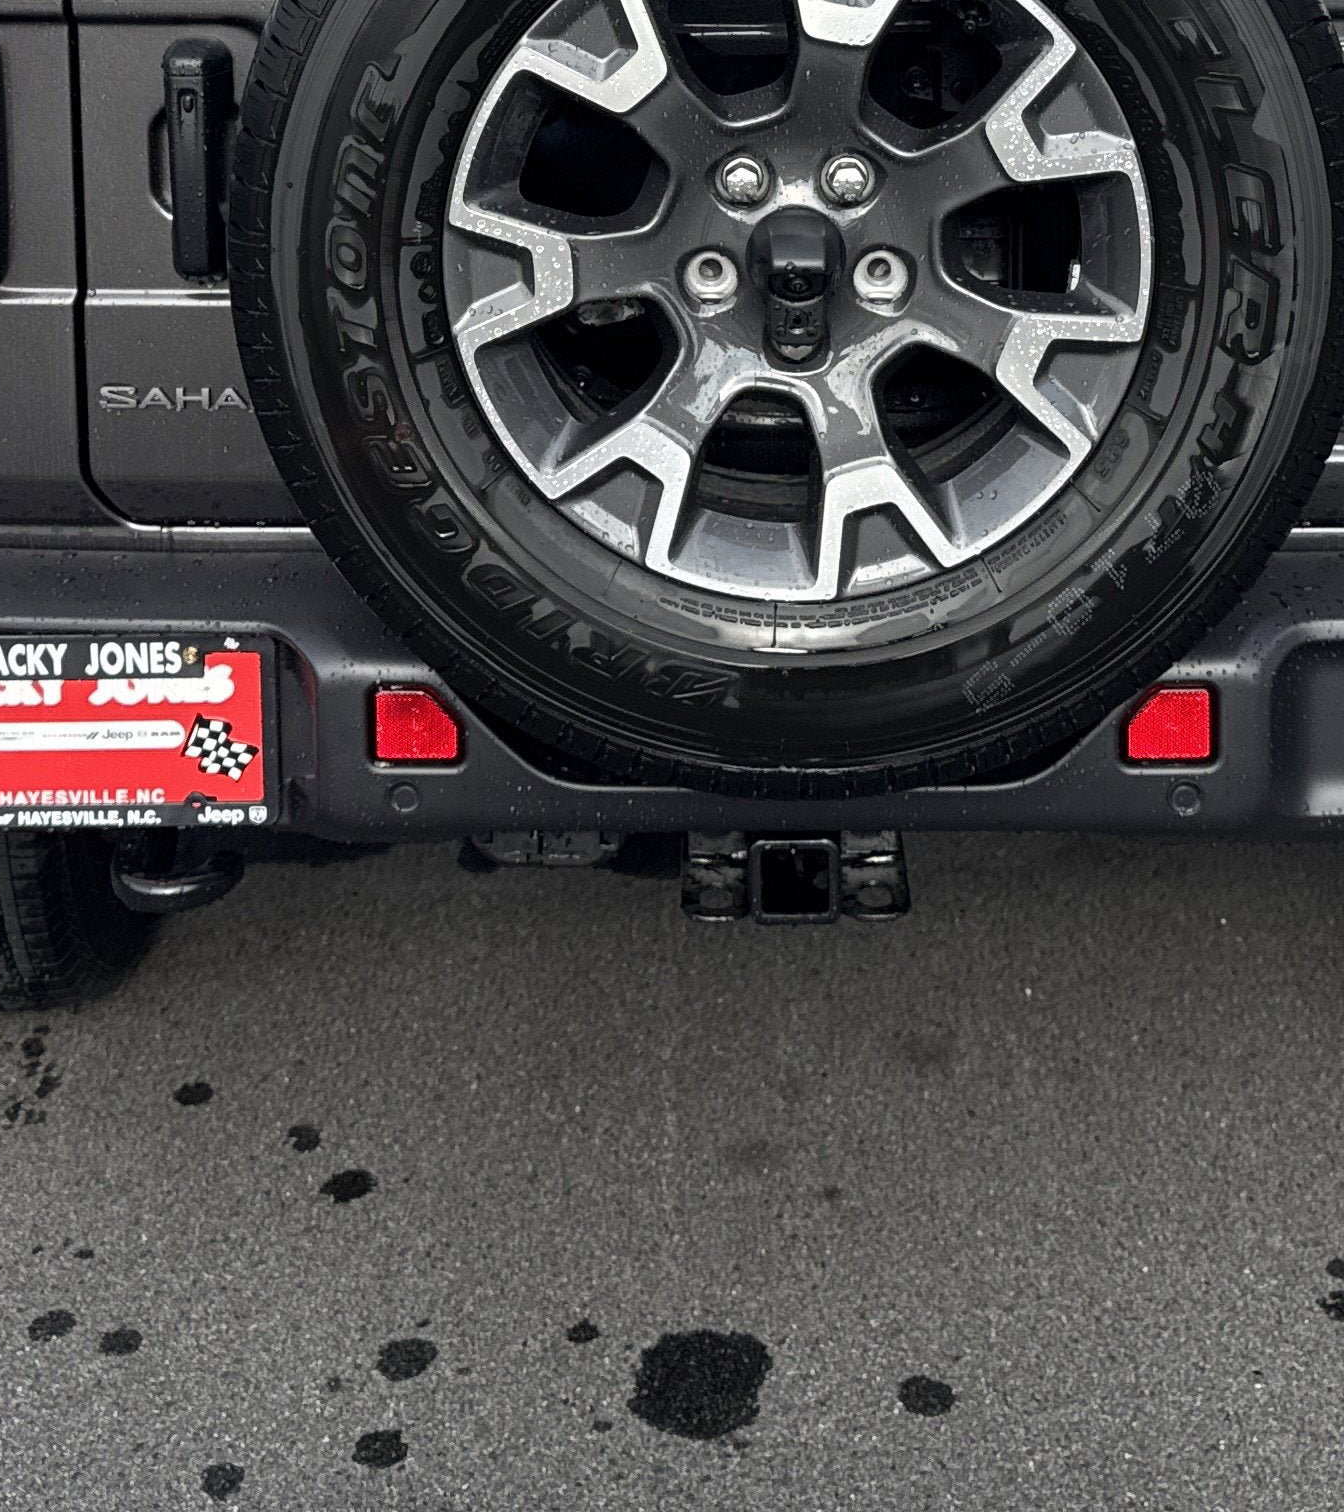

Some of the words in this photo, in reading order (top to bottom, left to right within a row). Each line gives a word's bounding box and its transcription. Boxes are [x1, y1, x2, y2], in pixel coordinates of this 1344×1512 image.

[325, 62, 740, 705] BRIDGESTONE
[99, 386, 254, 413] SAHA
[84, 641, 183, 676] JONES
[101, 728, 134, 741] Jeep
[17, 809, 125, 827] HAYESVILLE,
[126, 809, 162, 826] N.C.
[197, 805, 245, 826] Jeep
